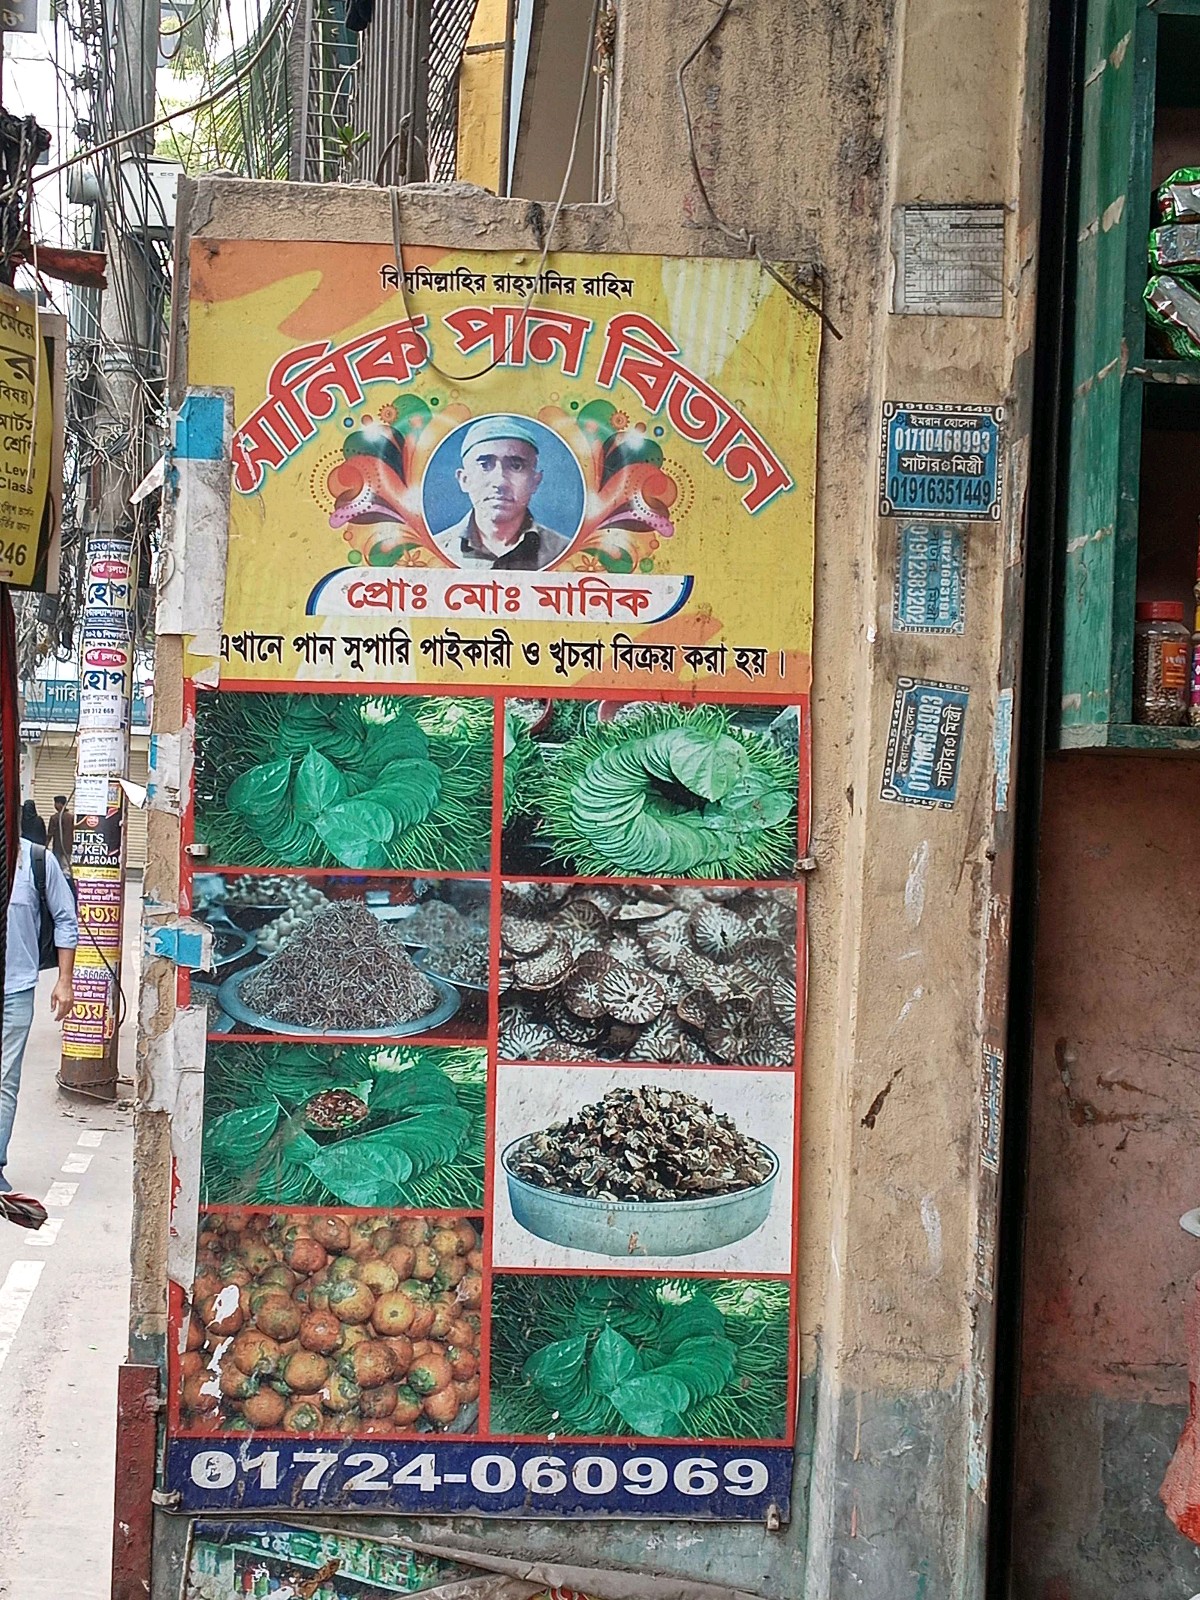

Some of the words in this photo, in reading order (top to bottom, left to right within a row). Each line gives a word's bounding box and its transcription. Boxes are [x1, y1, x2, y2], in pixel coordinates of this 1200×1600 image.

[582, 272, 634, 299] রাহিম
[231, 314, 431, 494] মানিক
[443, 306, 593, 376] পান
[596, 311, 794, 515] বিতান
[910, 414, 942, 427] ইমরান
[944, 417, 978, 428] হোসেন
[895, 427, 991, 454] 01710468993
[901, 453, 942, 472] সাটার
[890, 476, 991, 506] 01916351449
[905, 525, 929, 624] 01912383202
[347, 577, 428, 613] প্রোঃ
[445, 580, 521, 614] মোঃ
[531, 577, 652, 617] মানিক
[219, 631, 284, 664] এখানে
[292, 632, 336, 665] পান
[341, 627, 412, 672] সুপারি
[420, 628, 513, 670] পাইকারী
[522, 642, 540, 667] ও
[550, 638, 604, 678] খুচরা
[610, 633, 676, 673] বিক্রয়
[682, 643, 728, 676] করা
[733, 646, 767, 680] হয়
[935, 746, 957, 787] সাটার
[190, 1449, 770, 1498] 01724-060969
